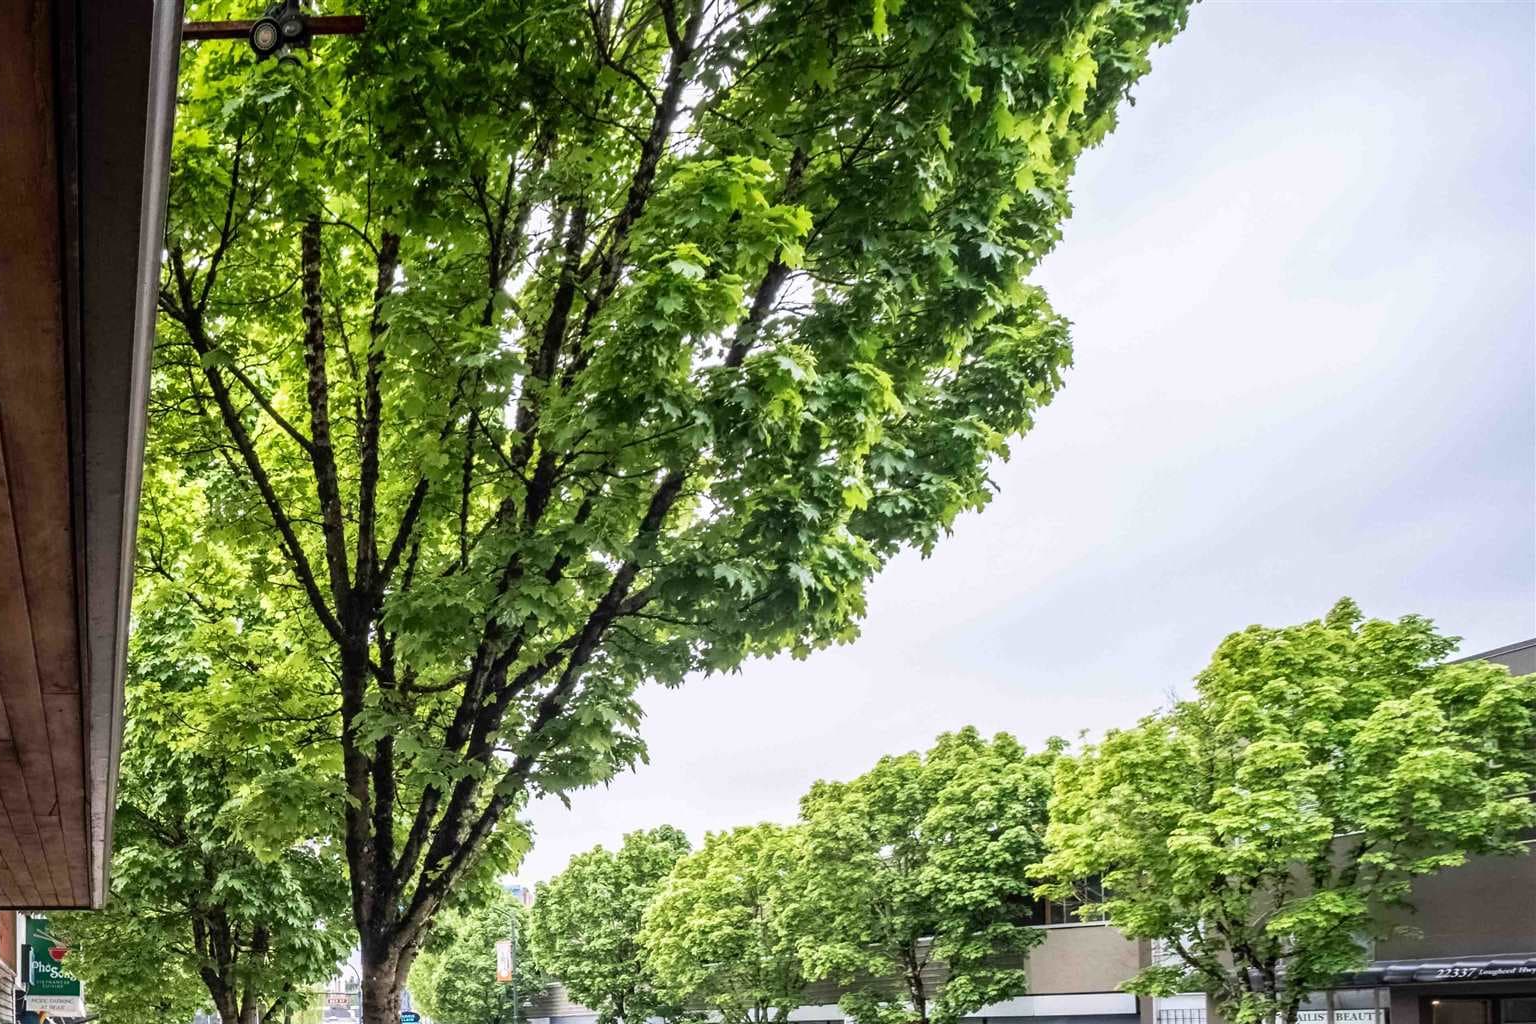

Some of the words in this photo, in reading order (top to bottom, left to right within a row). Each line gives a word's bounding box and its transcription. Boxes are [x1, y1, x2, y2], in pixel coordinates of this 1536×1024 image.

[1434, 967, 1478, 979] 22337
[1479, 967, 1517, 977] Lougheed
[1518, 966, 1536, 975] Hwy
[1335, 1011, 1383, 1021] BEAUT
